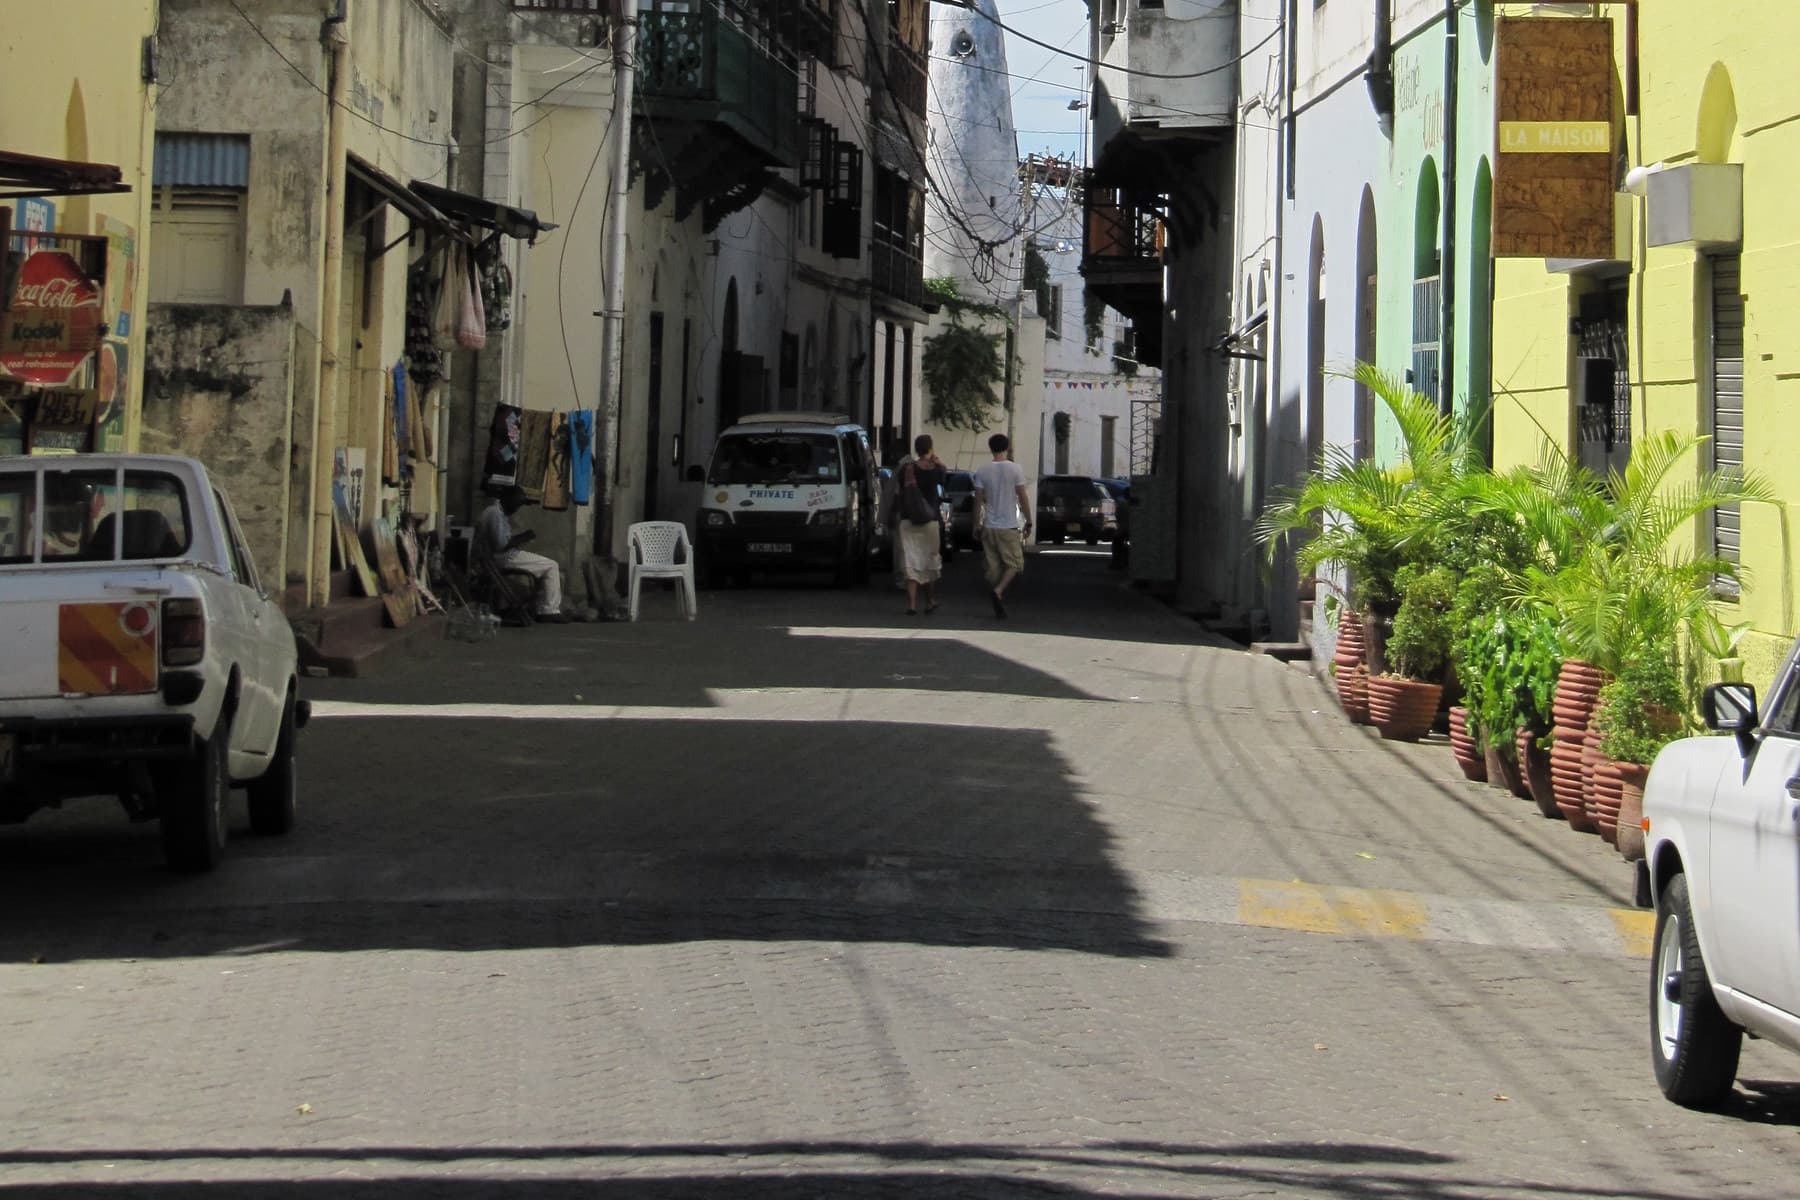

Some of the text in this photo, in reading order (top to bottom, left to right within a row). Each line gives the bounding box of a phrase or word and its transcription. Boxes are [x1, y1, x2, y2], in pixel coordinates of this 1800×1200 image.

[1505, 127, 1605, 146] LA MAISON
[15, 277, 82, 308] ca-Cola
[12, 321, 65, 341] Kodak
[8, 360, 75, 368] real refreshment
[43, 390, 84, 408] DIET
[749, 489, 795, 499] PRIVATE
